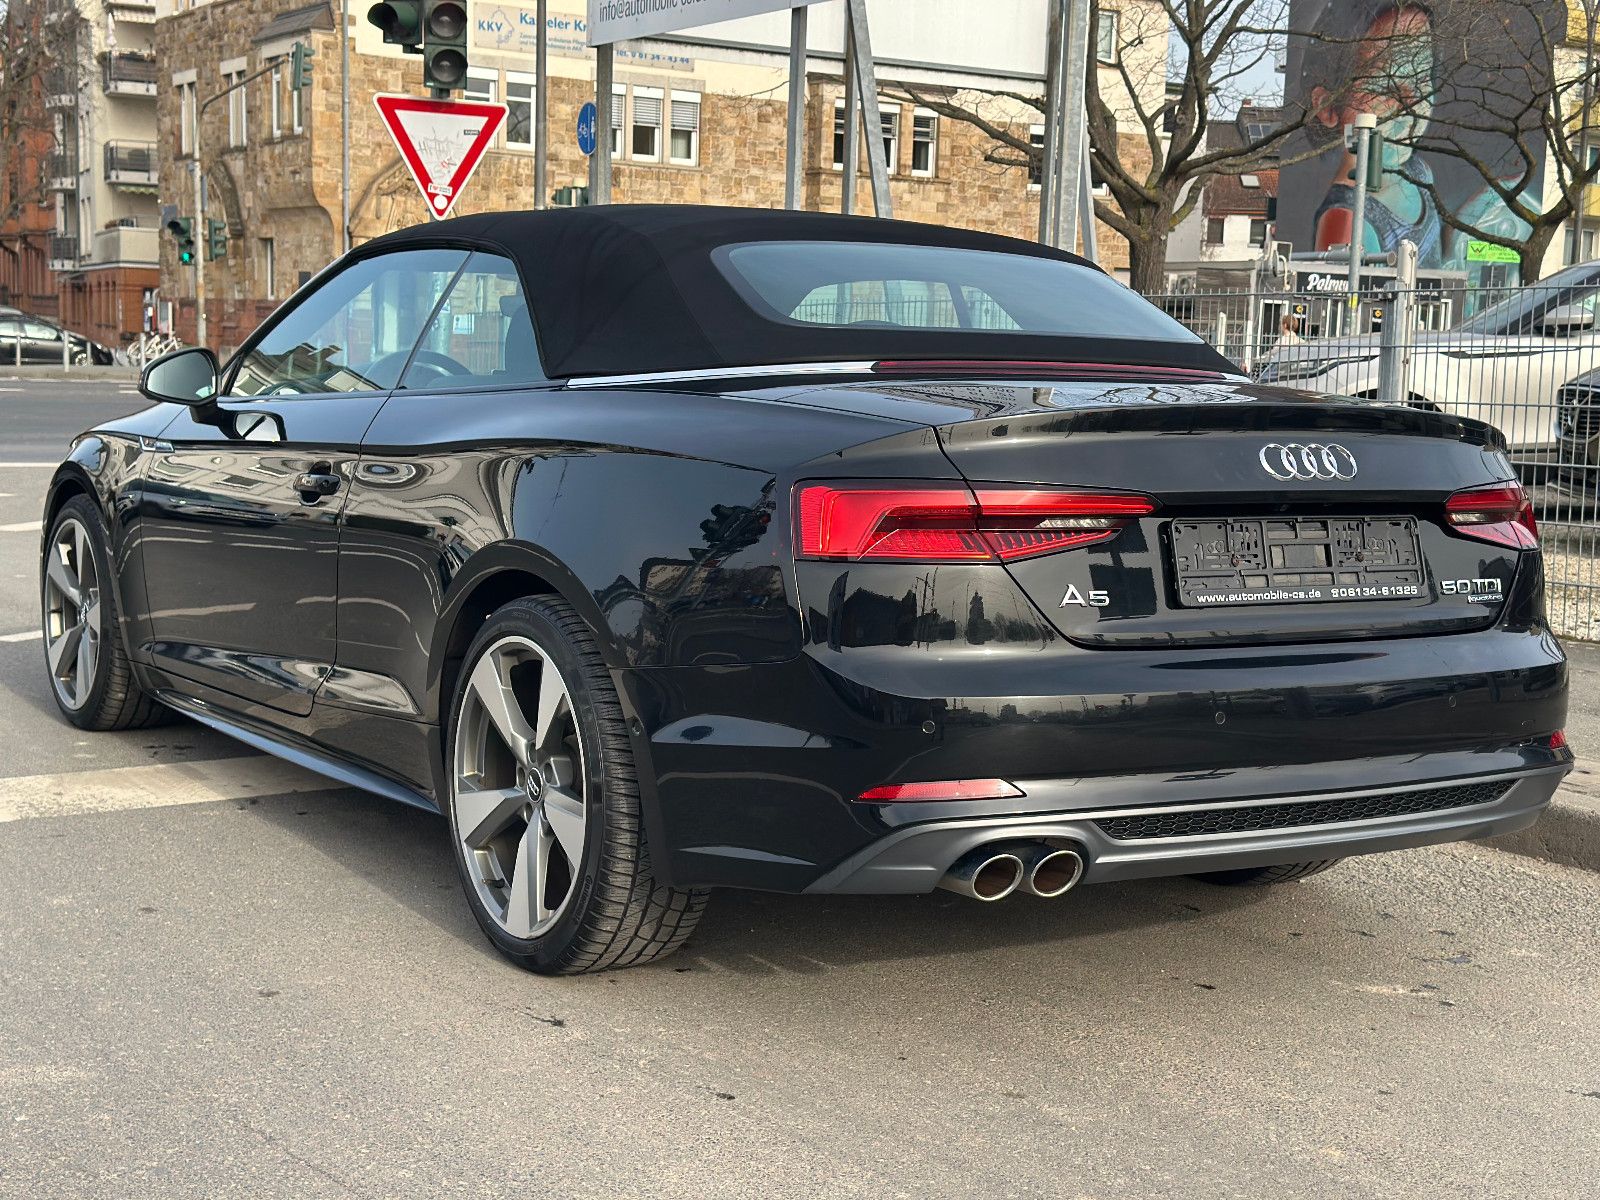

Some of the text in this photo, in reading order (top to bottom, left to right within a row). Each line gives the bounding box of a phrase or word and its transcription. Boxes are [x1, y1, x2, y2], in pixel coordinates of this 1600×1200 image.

[478, 19, 503, 32] KKV
[519, 12, 571, 30] Kaeler
[1059, 583, 1110, 608] A5
[1196, 585, 1418, 603] www.automobile-cs.de 06134-61325
[1468, 593, 1503, 603] quattro
